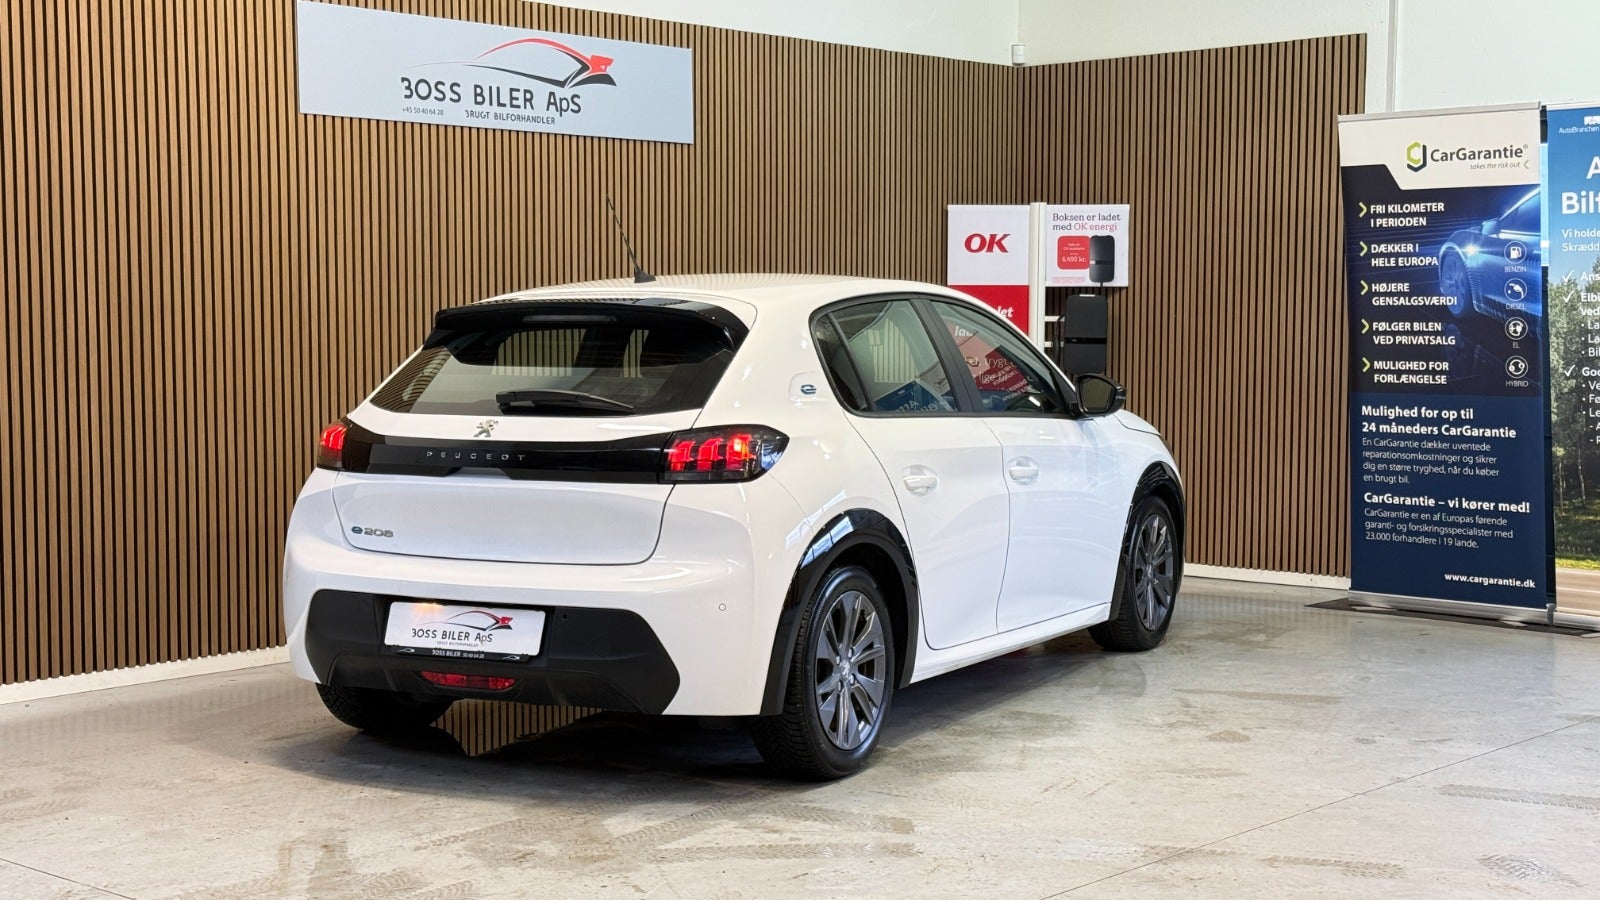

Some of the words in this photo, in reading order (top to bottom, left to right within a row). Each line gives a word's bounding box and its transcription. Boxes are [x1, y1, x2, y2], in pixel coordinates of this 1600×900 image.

[474, 84, 534, 110] BILER
[546, 91, 582, 117] ApS
[494, 112, 555, 125] BILFORHANDLER
[1470, 162, 1485, 170] takes
[1371, 204, 1386, 215] FRI
[1388, 202, 1445, 213] KILOMETER
[1053, 213, 1084, 221] Boksen
[1098, 213, 1121, 221] ladet
[1371, 220, 1374, 228] I
[1375, 217, 1427, 227] PERIODEN
[1053, 223, 1072, 231] med
[1089, 223, 1117, 232] energi
[1562, 230, 1572, 238] Vi
[964, 233, 1012, 253] OK
[1371, 244, 1413, 254] DÆKKER
[1416, 243, 1419, 252] I
[1371, 257, 1396, 267] HELE
[1398, 256, 1438, 266] EUROPA
[1371, 283, 1409, 293] HØJERE
[1372, 296, 1457, 306] GENSALGSVÆRDI
[1373, 322, 1412, 332] FØLGER
[1414, 322, 1442, 332] BILEN
[1373, 335, 1393, 345] VED
[1396, 336, 1456, 345] PRIVATSALG
[1374, 360, 1427, 371] MULIGHED
[1429, 362, 1449, 371] FOR
[1374, 374, 1447, 384] FORLÆNGELSE
[1362, 406, 1418, 420] Mulighed
[1421, 407, 1437, 418] for
[1442, 409, 1457, 420] op
[1459, 408, 1473, 419] til
[1362, 423, 1376, 433] 24
[1379, 422, 1438, 436] måneders
[1441, 425, 1516, 438] CarGarantie
[1362, 438, 1372, 446] En
[1374, 438, 1419, 449] CarGarantie
[1421, 440, 1450, 450] dækker
[1452, 442, 1491, 451] uventede
[426, 451, 525, 461] PEUGEOT
[1363, 451, 1460, 463] reparationsomkostninger
[1462, 456, 1474, 464] og
[1476, 455, 1497, 464] sikrer
[1363, 462, 1375, 471] dig
[1389, 463, 1411, 472] større
[1413, 464, 1446, 475] tryghed,
[1448, 465, 1461, 475] når
[1463, 466, 1474, 475] du
[1476, 467, 1499, 476] køber
[1375, 474, 1396, 485] brugt
[1399, 475, 1410, 483] bil.
[1364, 493, 1435, 507] CarGarantie
[1448, 498, 1459, 508] vi
[1462, 499, 1495, 512] kører
[1499, 502, 1530, 513] med!
[1365, 509, 1410, 519] CarGarantie
[1411, 511, 1419, 519] er
[1421, 512, 1431, 520] en
[1433, 512, 1440, 521] af
[1442, 513, 1474, 524] Europas
[1476, 514, 1507, 526] førende
[1365, 521, 1395, 531] garanti-
[1396, 524, 1407, 532] og
[1408, 523, 1493, 537] forsikringsspecialister
[1495, 529, 1513, 538] med
[1365, 532, 1391, 541] 23.000
[1393, 533, 1437, 545] forhandlere
[1438, 537, 1441, 545] i
[1443, 537, 1453, 546] 19
[1454, 538, 1479, 548] lande.
[1445, 573, 1535, 588] www.cargarantie.dk
[442, 630, 469, 641] BILER
[475, 632, 493, 644] ApS
